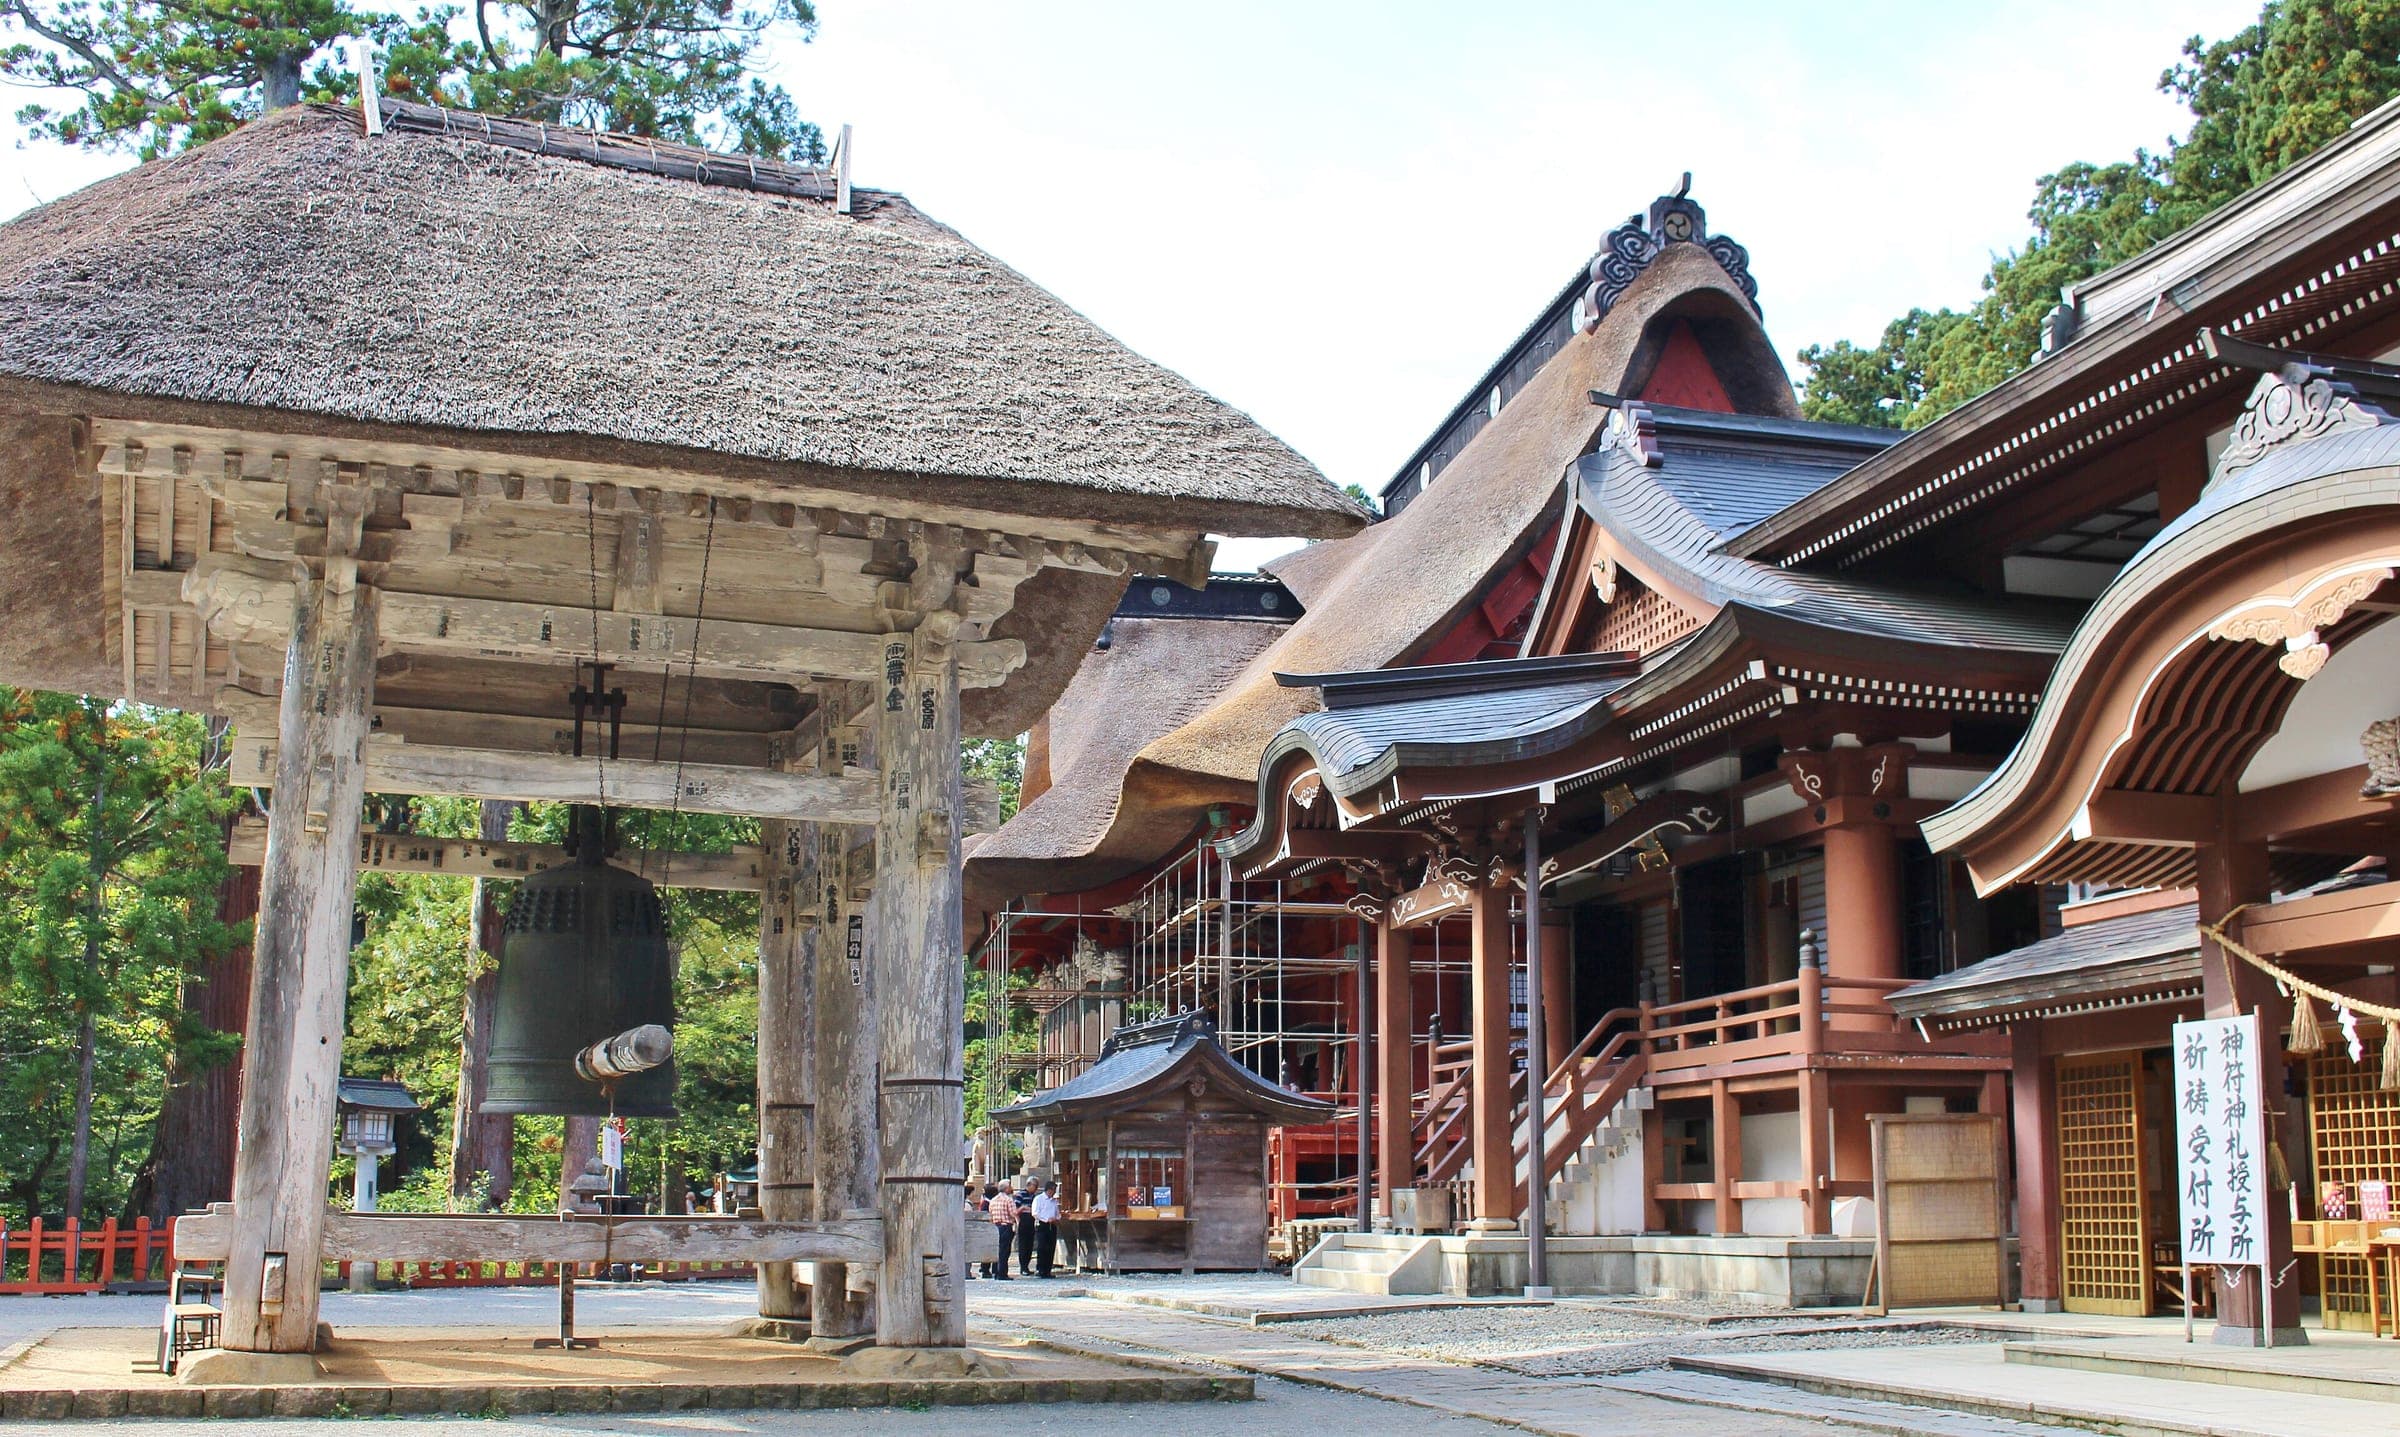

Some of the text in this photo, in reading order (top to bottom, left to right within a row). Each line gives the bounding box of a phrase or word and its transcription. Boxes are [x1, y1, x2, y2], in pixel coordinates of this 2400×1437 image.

[2183, 1032, 2216, 1257] 祈祷受付所
[2220, 1024, 2254, 1261] 神符神札授与所
